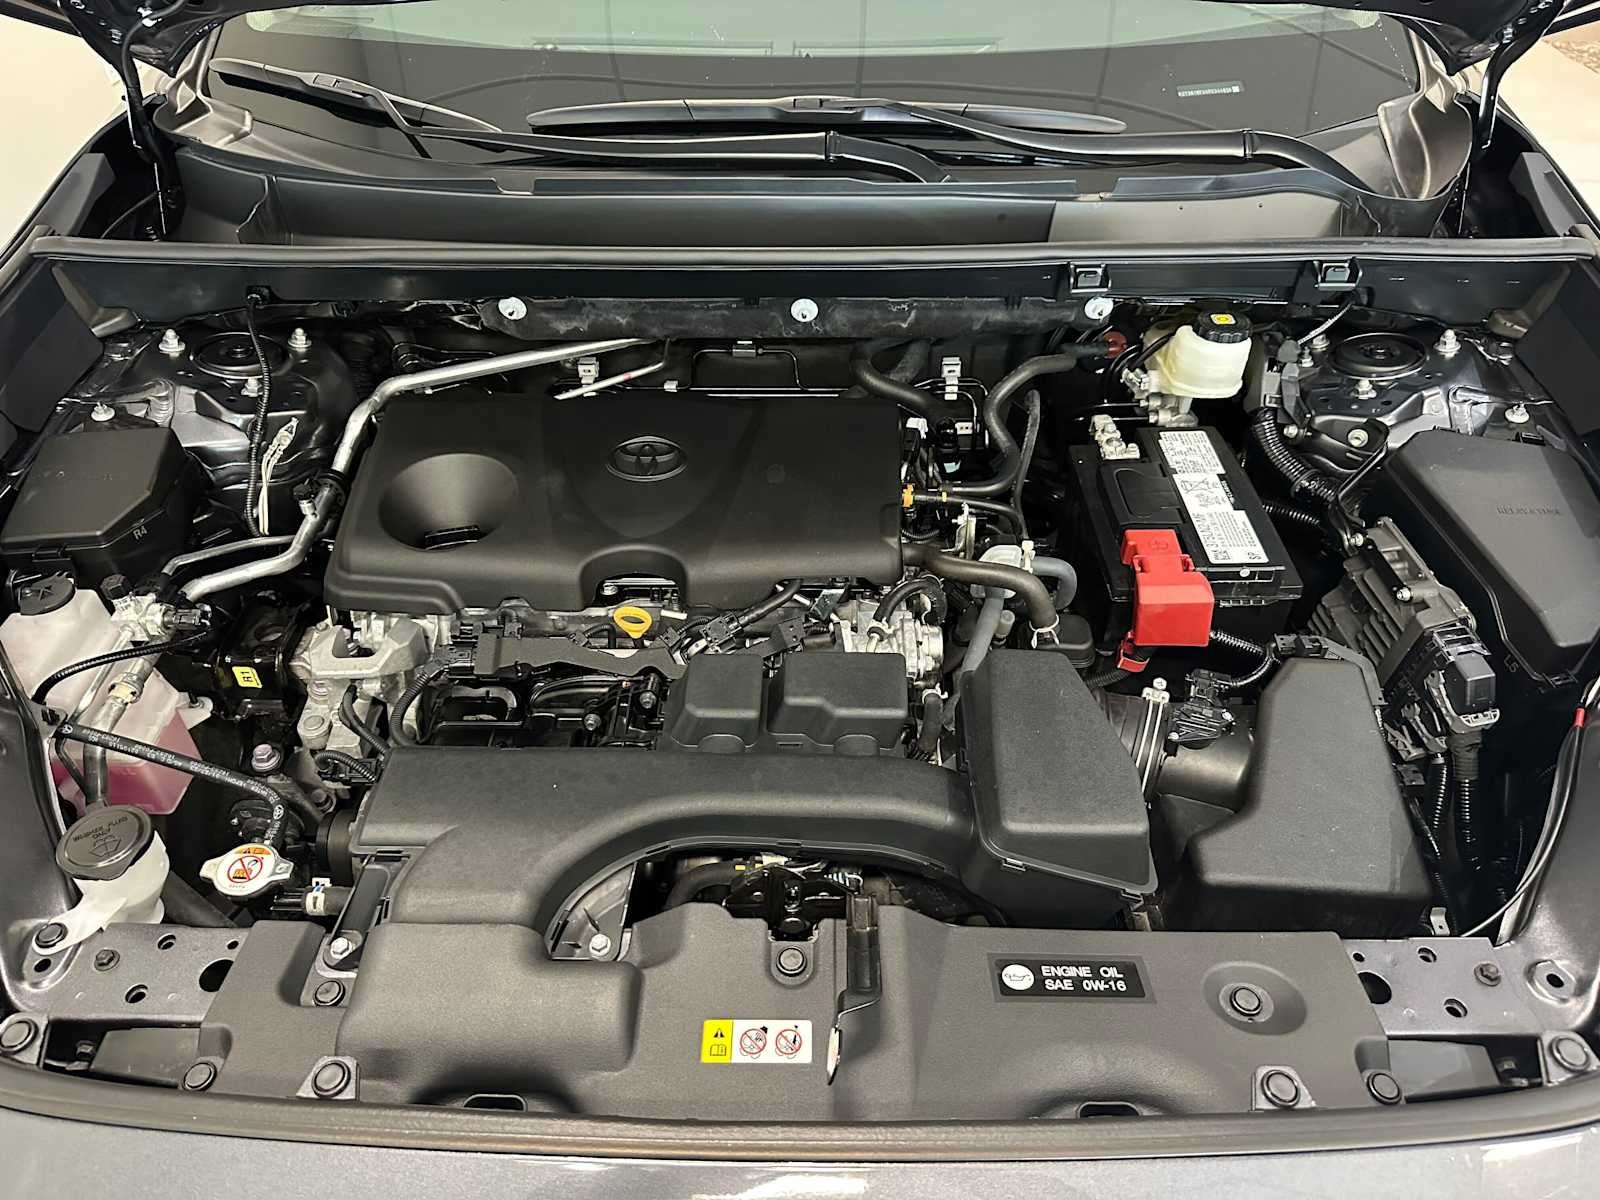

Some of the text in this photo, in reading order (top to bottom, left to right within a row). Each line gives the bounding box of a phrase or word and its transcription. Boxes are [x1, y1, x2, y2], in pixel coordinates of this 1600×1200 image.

[133, 526, 147, 540] R4
[1041, 965, 1123, 978] ENGINE OIL
[1045, 979, 1127, 992] SAE 0W-16
